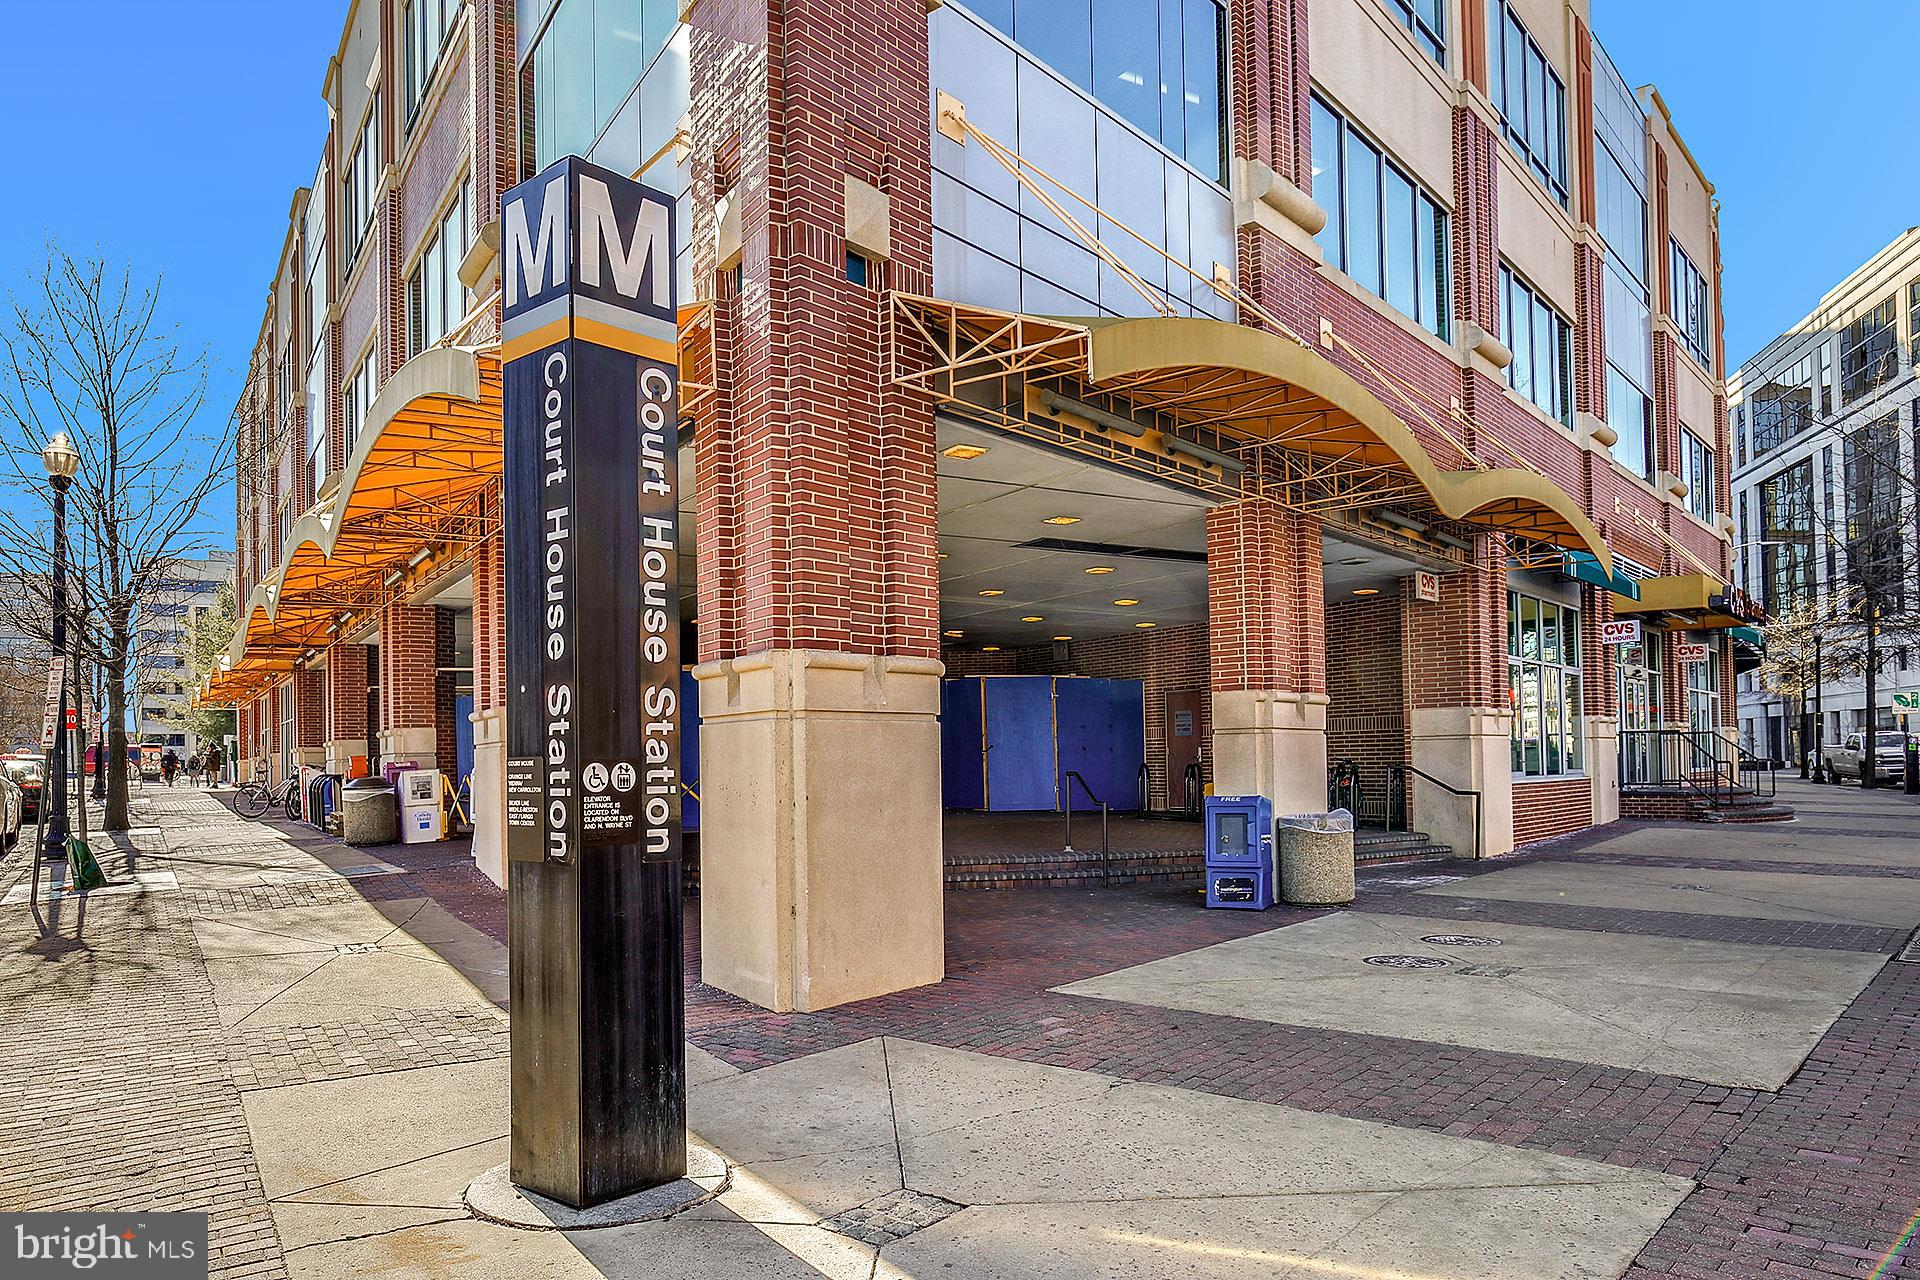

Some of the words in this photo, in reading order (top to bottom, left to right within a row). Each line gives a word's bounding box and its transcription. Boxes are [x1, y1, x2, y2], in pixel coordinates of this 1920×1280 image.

[505, 174, 566, 310] M
[578, 173, 671, 310] M
[544, 351, 567, 487] Court
[640, 367, 673, 497] Court
[546, 506, 569, 661] House
[642, 516, 674, 663] House
[1421, 573, 1435, 590] CVS
[1604, 622, 1635, 635] CVS
[1678, 645, 1705, 656] CVS
[547, 684, 572, 857] Station
[583, 795, 611, 803] ELEVATOR
[583, 815, 619, 823] CLARENDON
[644, 686, 677, 853] Station
